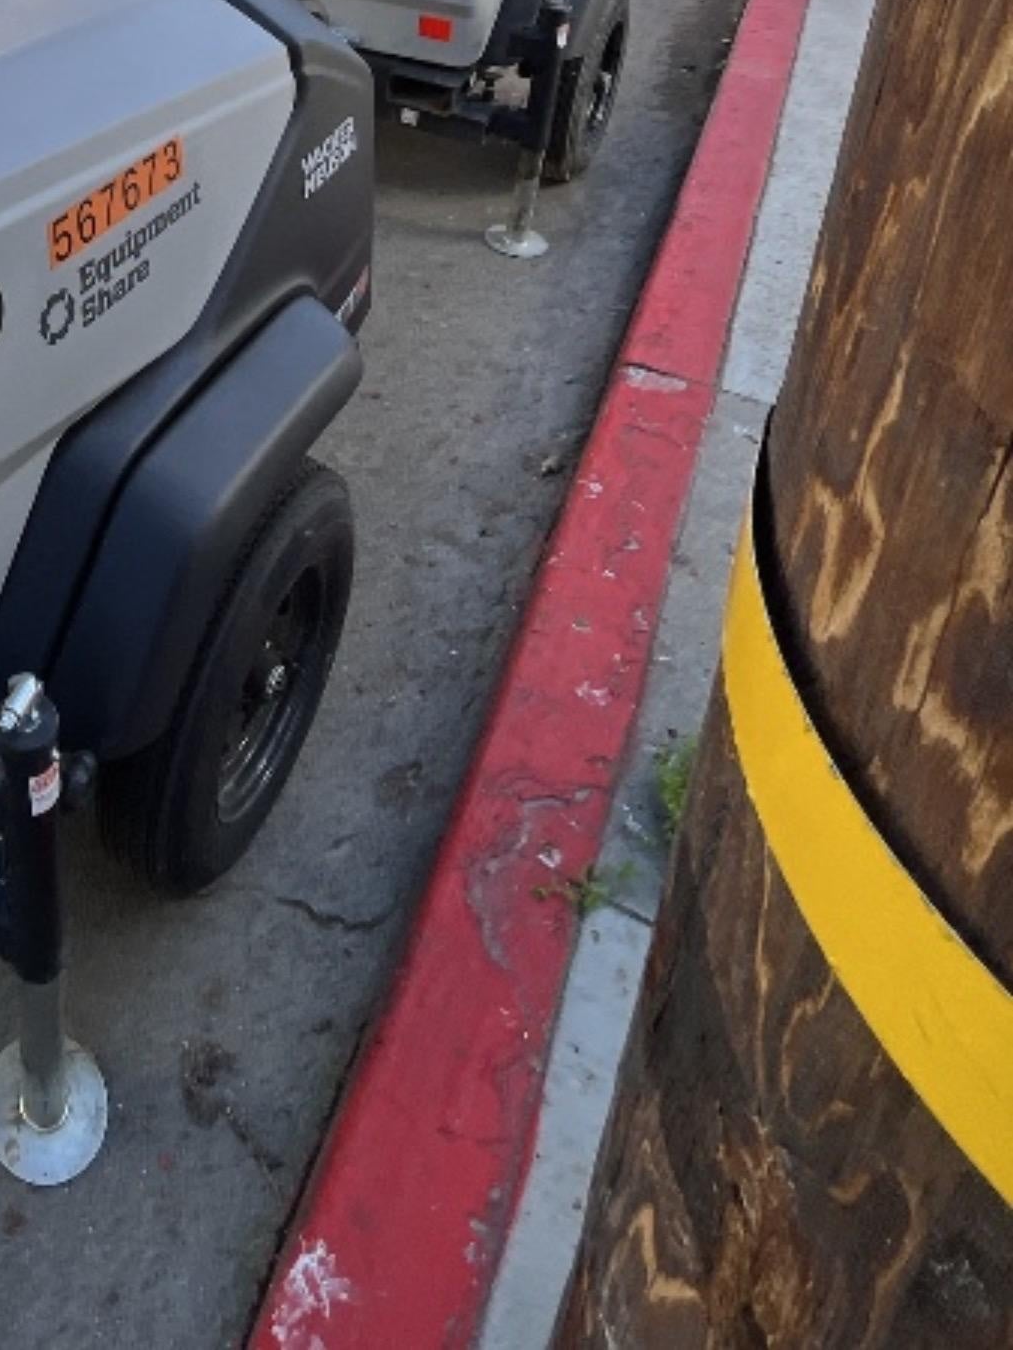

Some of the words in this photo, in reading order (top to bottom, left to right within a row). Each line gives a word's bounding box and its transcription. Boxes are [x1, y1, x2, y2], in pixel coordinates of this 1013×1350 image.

[52, 139, 181, 263] 567673
[78, 180, 202, 296] Equipment
[81, 259, 152, 328] Share
